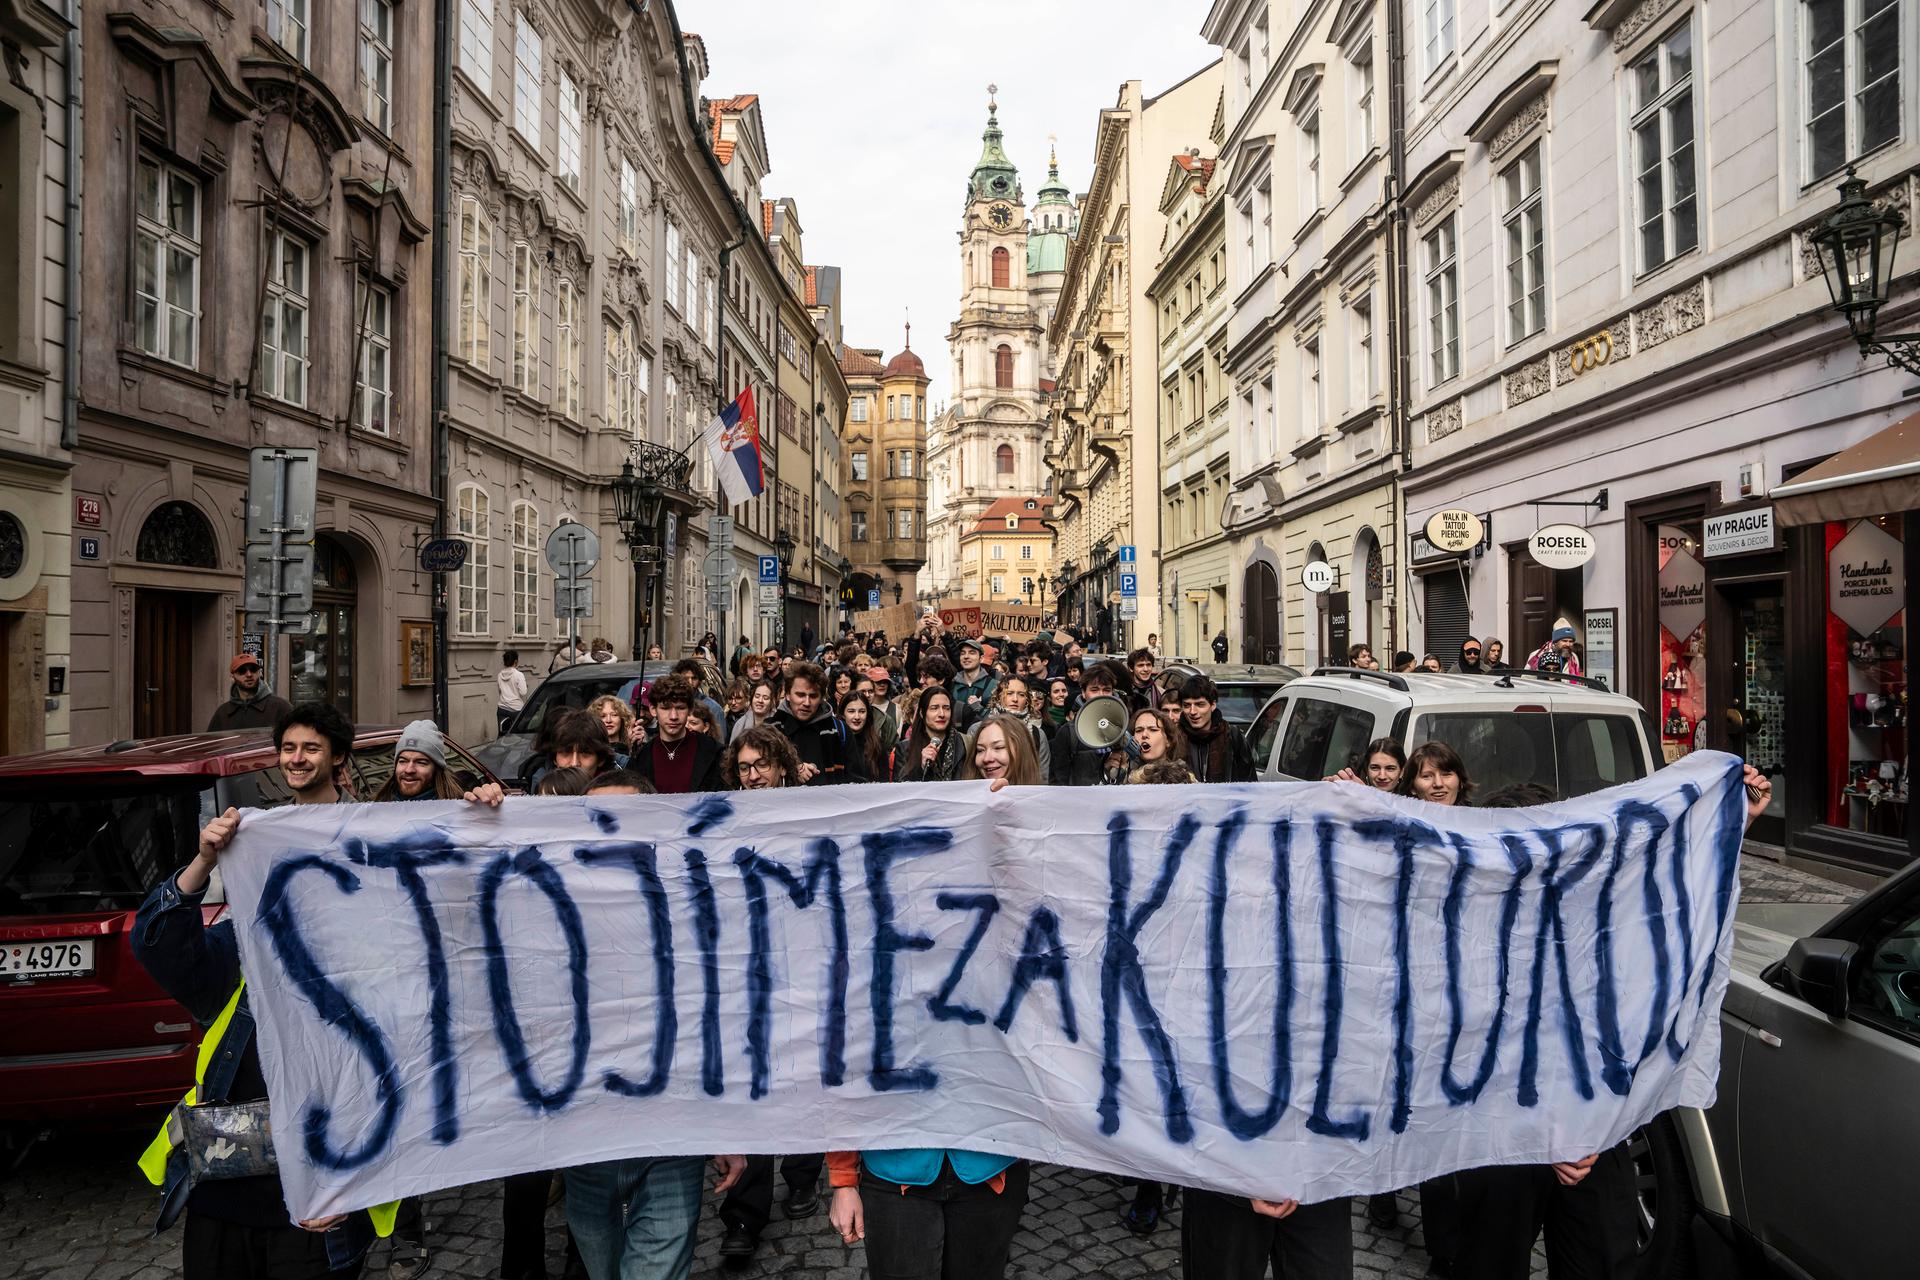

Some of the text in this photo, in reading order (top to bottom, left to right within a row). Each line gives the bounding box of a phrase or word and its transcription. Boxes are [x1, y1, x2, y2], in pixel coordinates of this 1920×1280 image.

[82, 500, 98, 513] 278
[1442, 513, 1468, 521] WALK IN
[1445, 521, 1466, 530] TATTOO
[1707, 514, 1768, 537] MY PRAGUE
[1441, 530, 1470, 539] PIERCING
[85, 542, 95, 554] 13
[1537, 536, 1587, 548] ROESEL
[1707, 535, 1769, 553] SOUVENIRS & DECOR
[762, 559, 775, 576] P
[1840, 559, 1892, 578] Handmade
[1124, 576, 1134, 590] P
[1844, 579, 1880, 588] PORCELAIN
[1660, 585, 1679, 599] Hand
[1840, 587, 1894, 598] BOHEMIA GLASS
[1587, 618, 1613, 629] ROESEL
[26, 944, 82, 969] 4976
[257, 764, 1745, 1171] STOJÍME ZA KULTUROU
